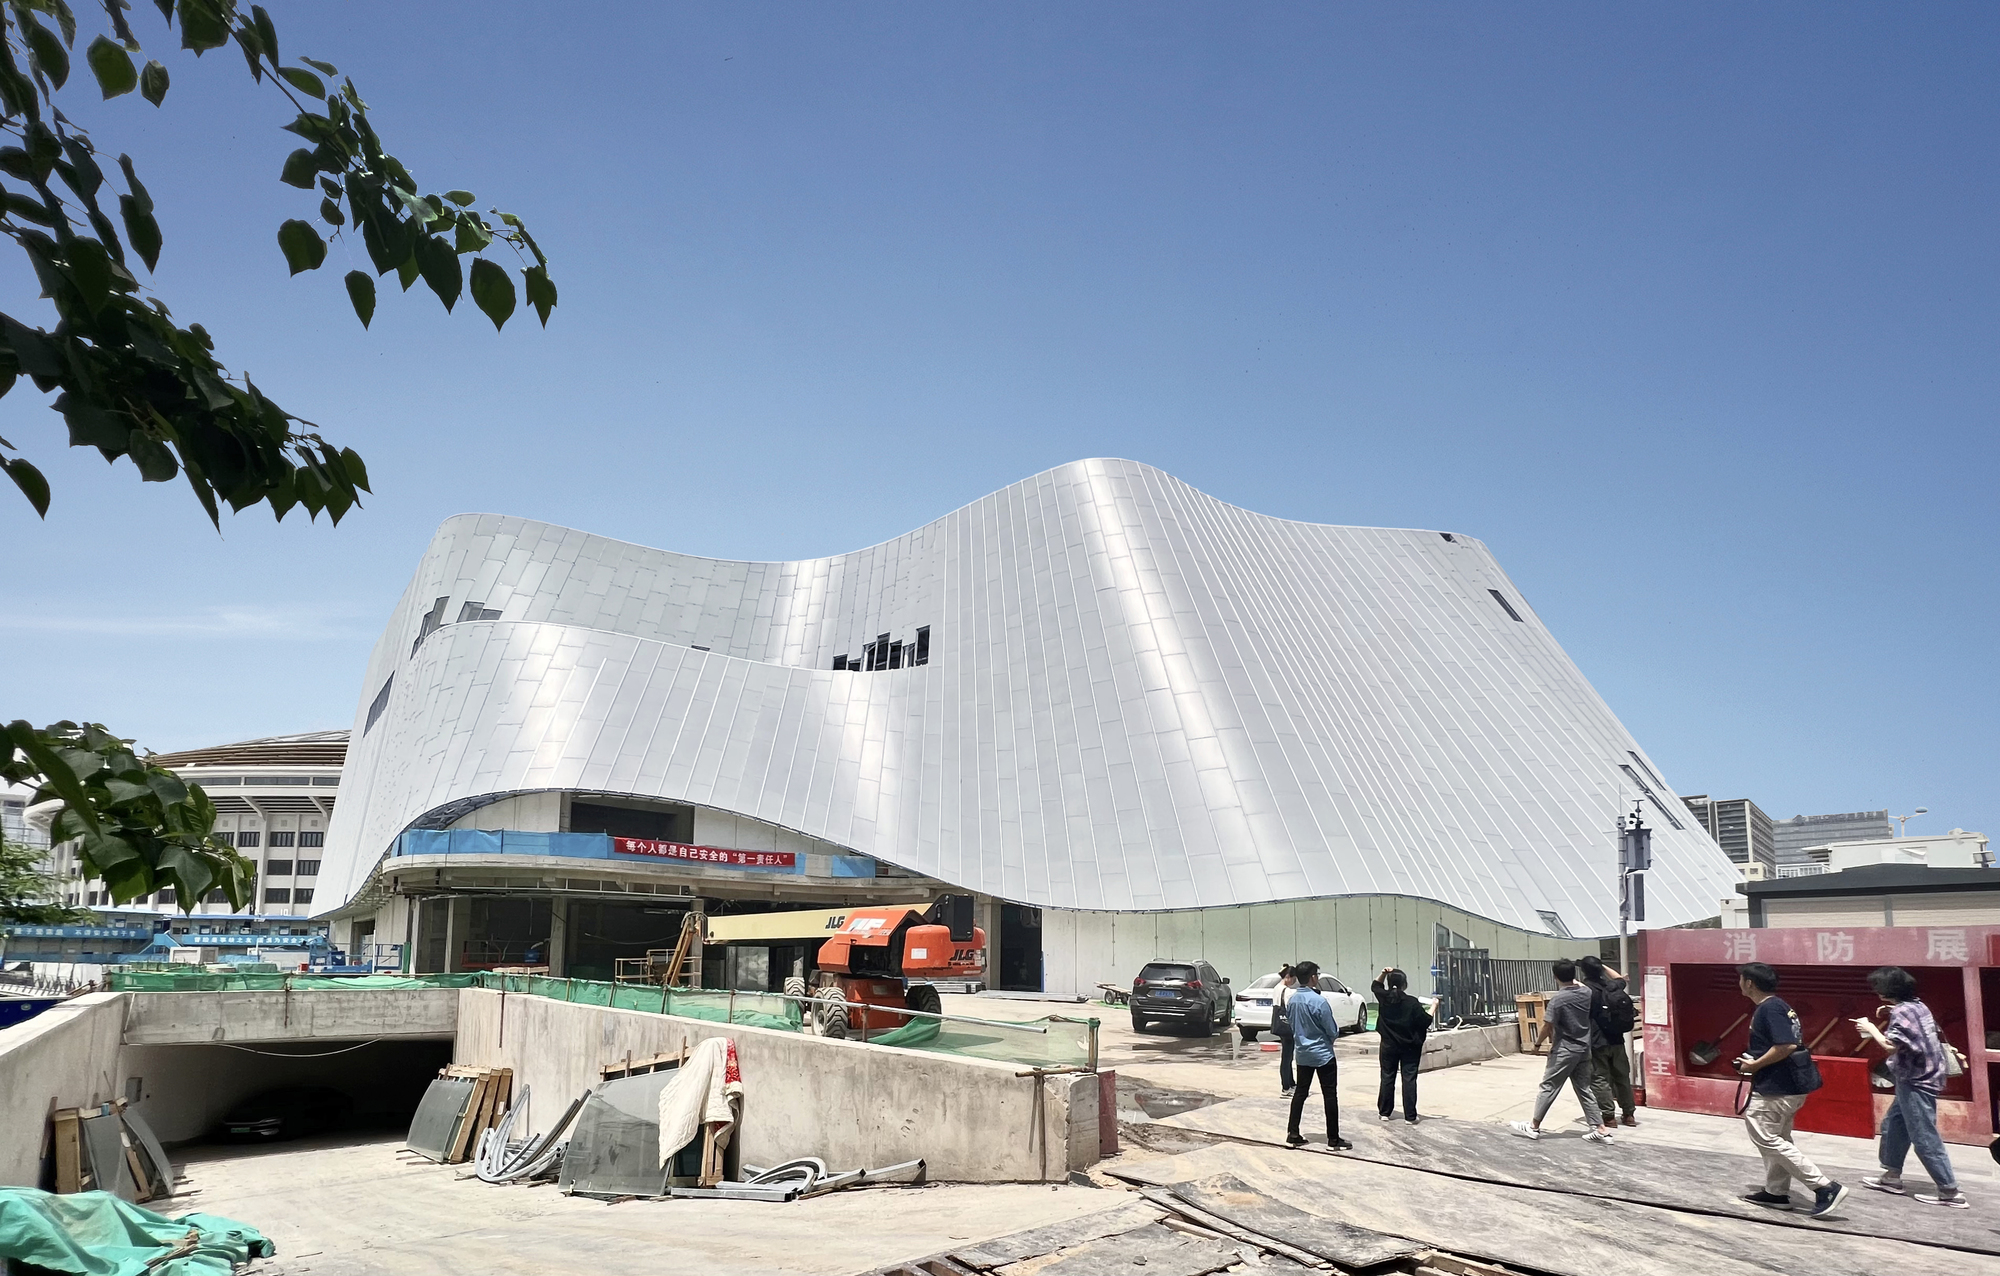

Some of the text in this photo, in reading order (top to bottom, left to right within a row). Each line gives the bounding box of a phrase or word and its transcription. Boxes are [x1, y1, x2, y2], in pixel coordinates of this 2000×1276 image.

[825, 915, 845, 929] JLG
[1723, 930, 1970, 962] 消防展
[949, 949, 975, 961] JLG
